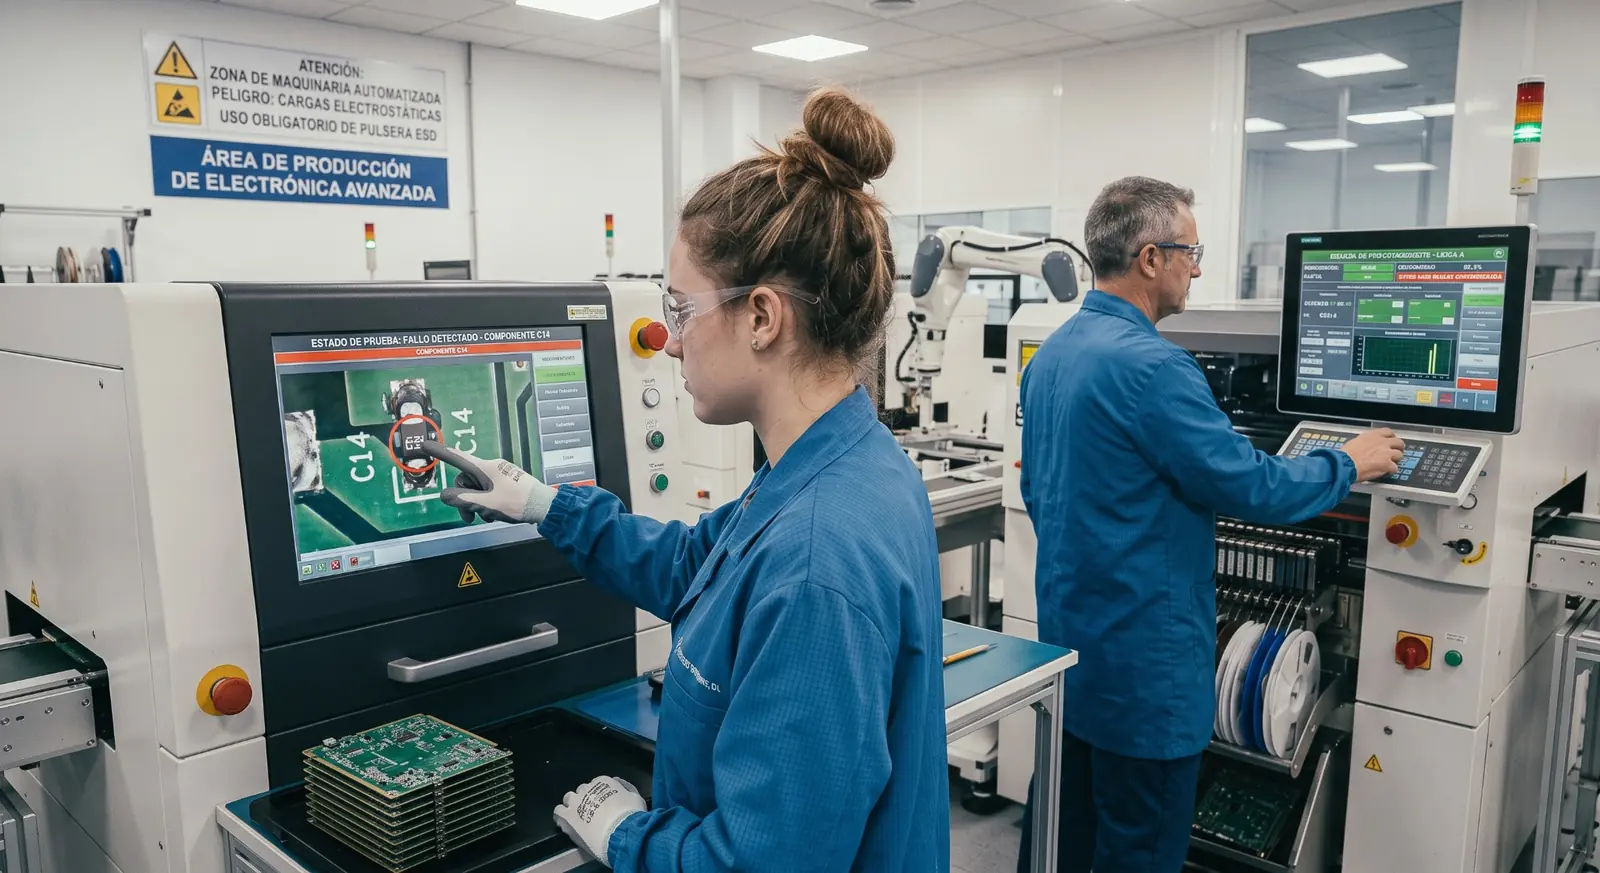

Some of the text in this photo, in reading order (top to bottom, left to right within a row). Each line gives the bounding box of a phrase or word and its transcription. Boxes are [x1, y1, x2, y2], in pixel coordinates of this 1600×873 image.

[210, 65, 442, 105] ZONA DE MAQUINARIA AUTOMATIZADA
[299, 59, 364, 79] ATENCIÓN:
[212, 86, 442, 122] PELIGRO: CARGAS ELECTROSTÁTICAS
[220, 109, 437, 141] USO OBLIGATORIO DE PULSERA ESD
[201, 144, 411, 179] ÁREA DE PRODUCCIÓN
[171, 170, 437, 202] DE ELECTRÓNICA AVANZADA
[311, 338, 348, 348] ESTADO
[350, 337, 362, 346] DE
[363, 335, 402, 346] PRUEBA:
[403, 334, 430, 344] FALLO
[431, 333, 479, 343] DETECTADO
[484, 331, 536, 341] COMPONENTE
[536, 330, 551, 339] C14
[416, 347, 456, 356] COMPONENTE
[451, 408, 477, 456] C14
[346, 431, 375, 482] C14
